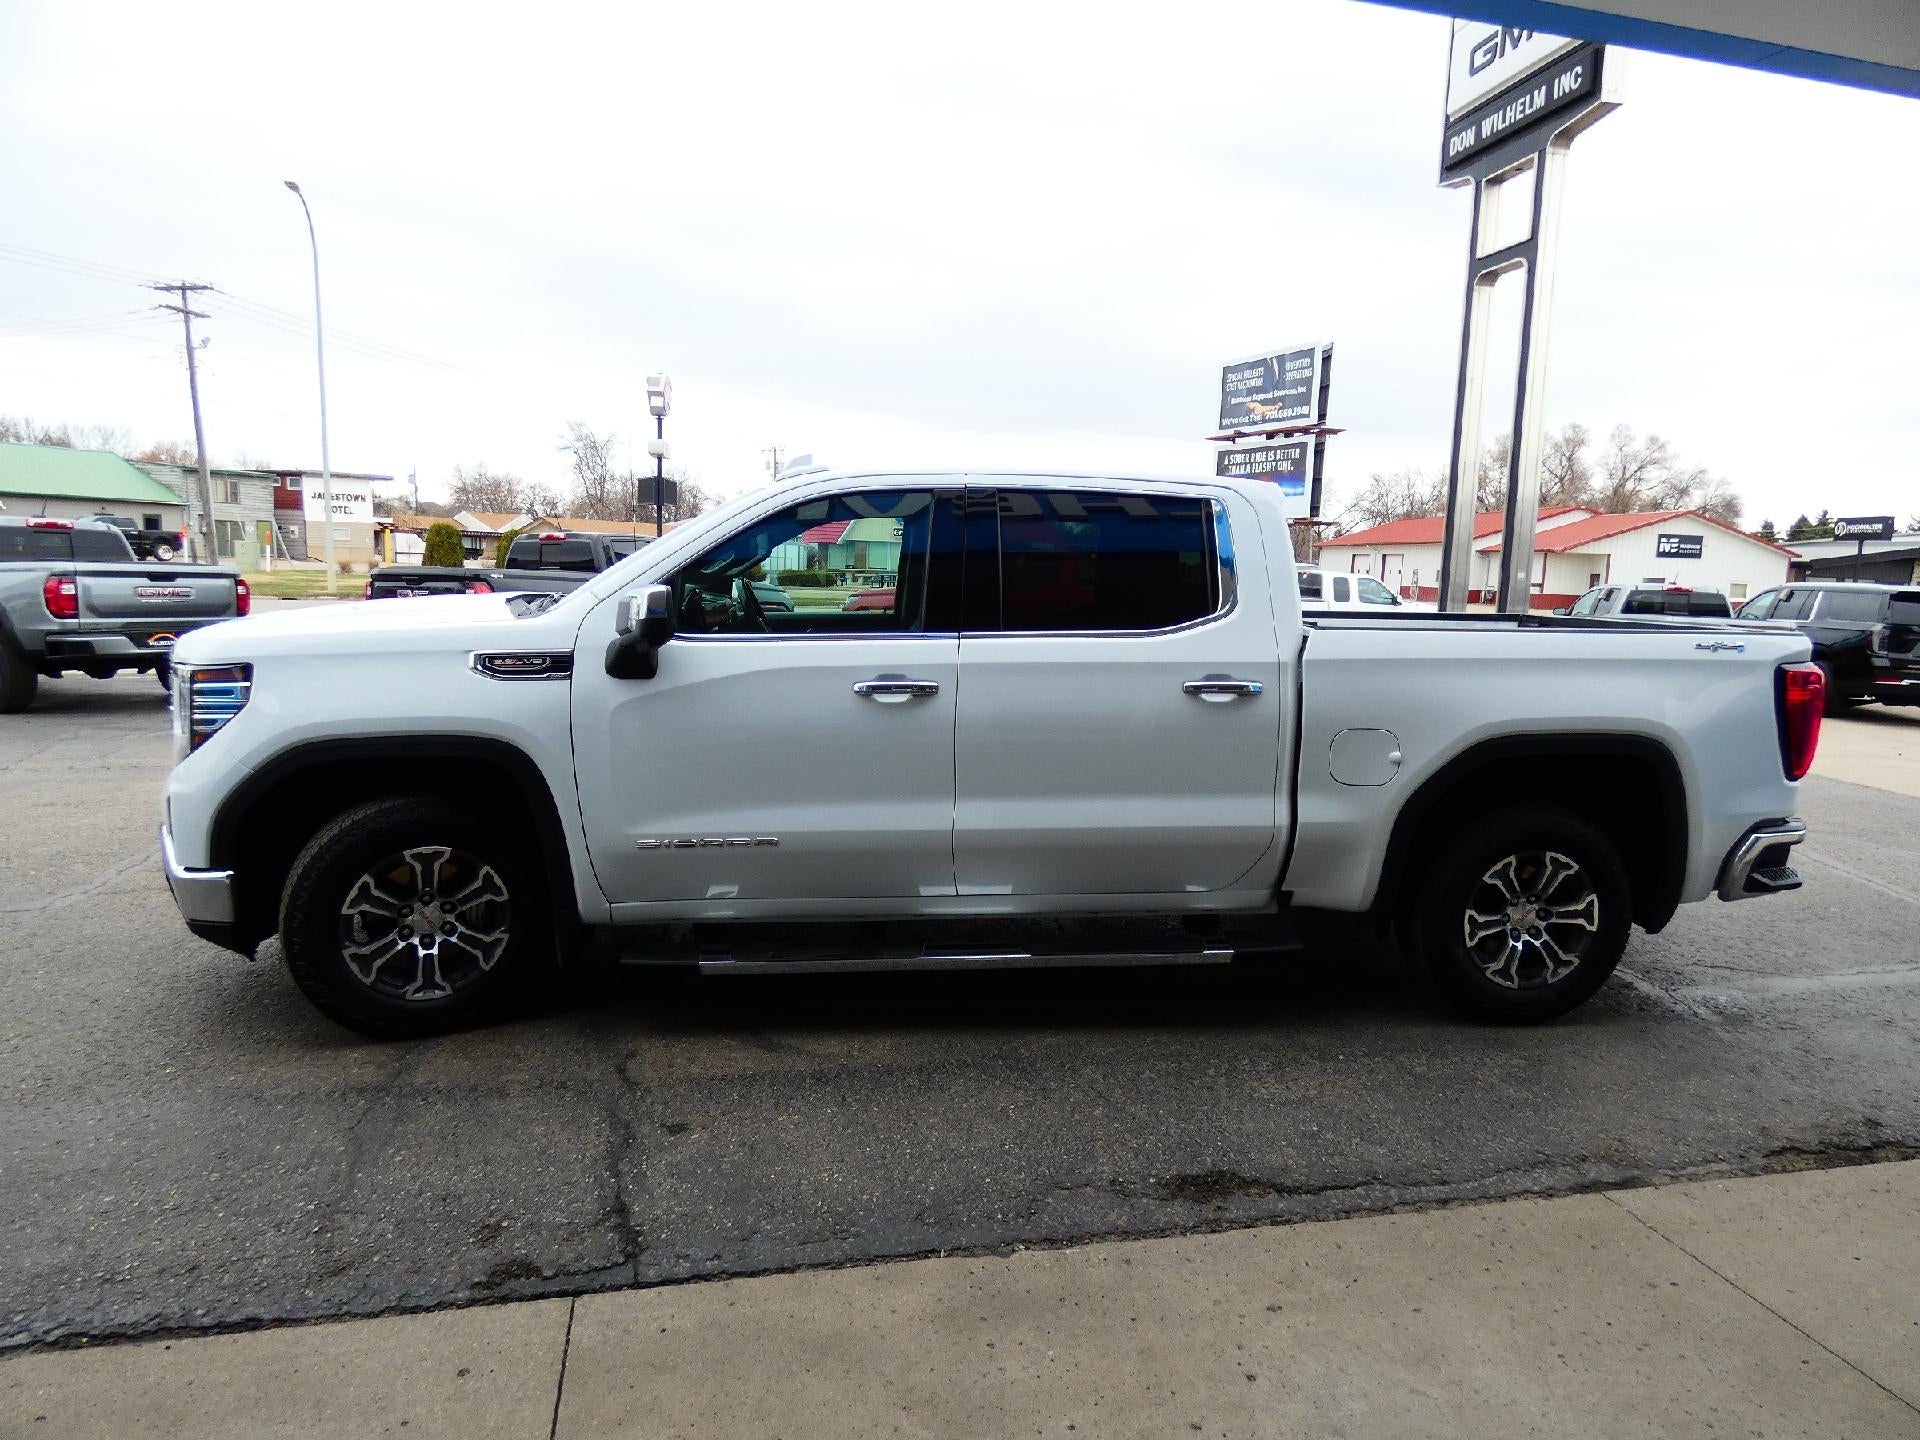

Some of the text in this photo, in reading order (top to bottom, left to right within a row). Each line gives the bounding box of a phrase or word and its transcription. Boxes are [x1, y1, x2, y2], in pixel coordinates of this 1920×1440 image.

[1450, 65, 1582, 156] DON WILHELM INC
[1224, 448, 1300, 464] A SOBER RIDE IS BETTER
[1229, 464, 1245, 474] THAN
[1246, 464, 1250, 473] A
[1252, 462, 1276, 473] FLASHY
[312, 492, 367, 502] JAESTOWN
[138, 587, 192, 598] GMC
[635, 837, 780, 849] SIERRA
